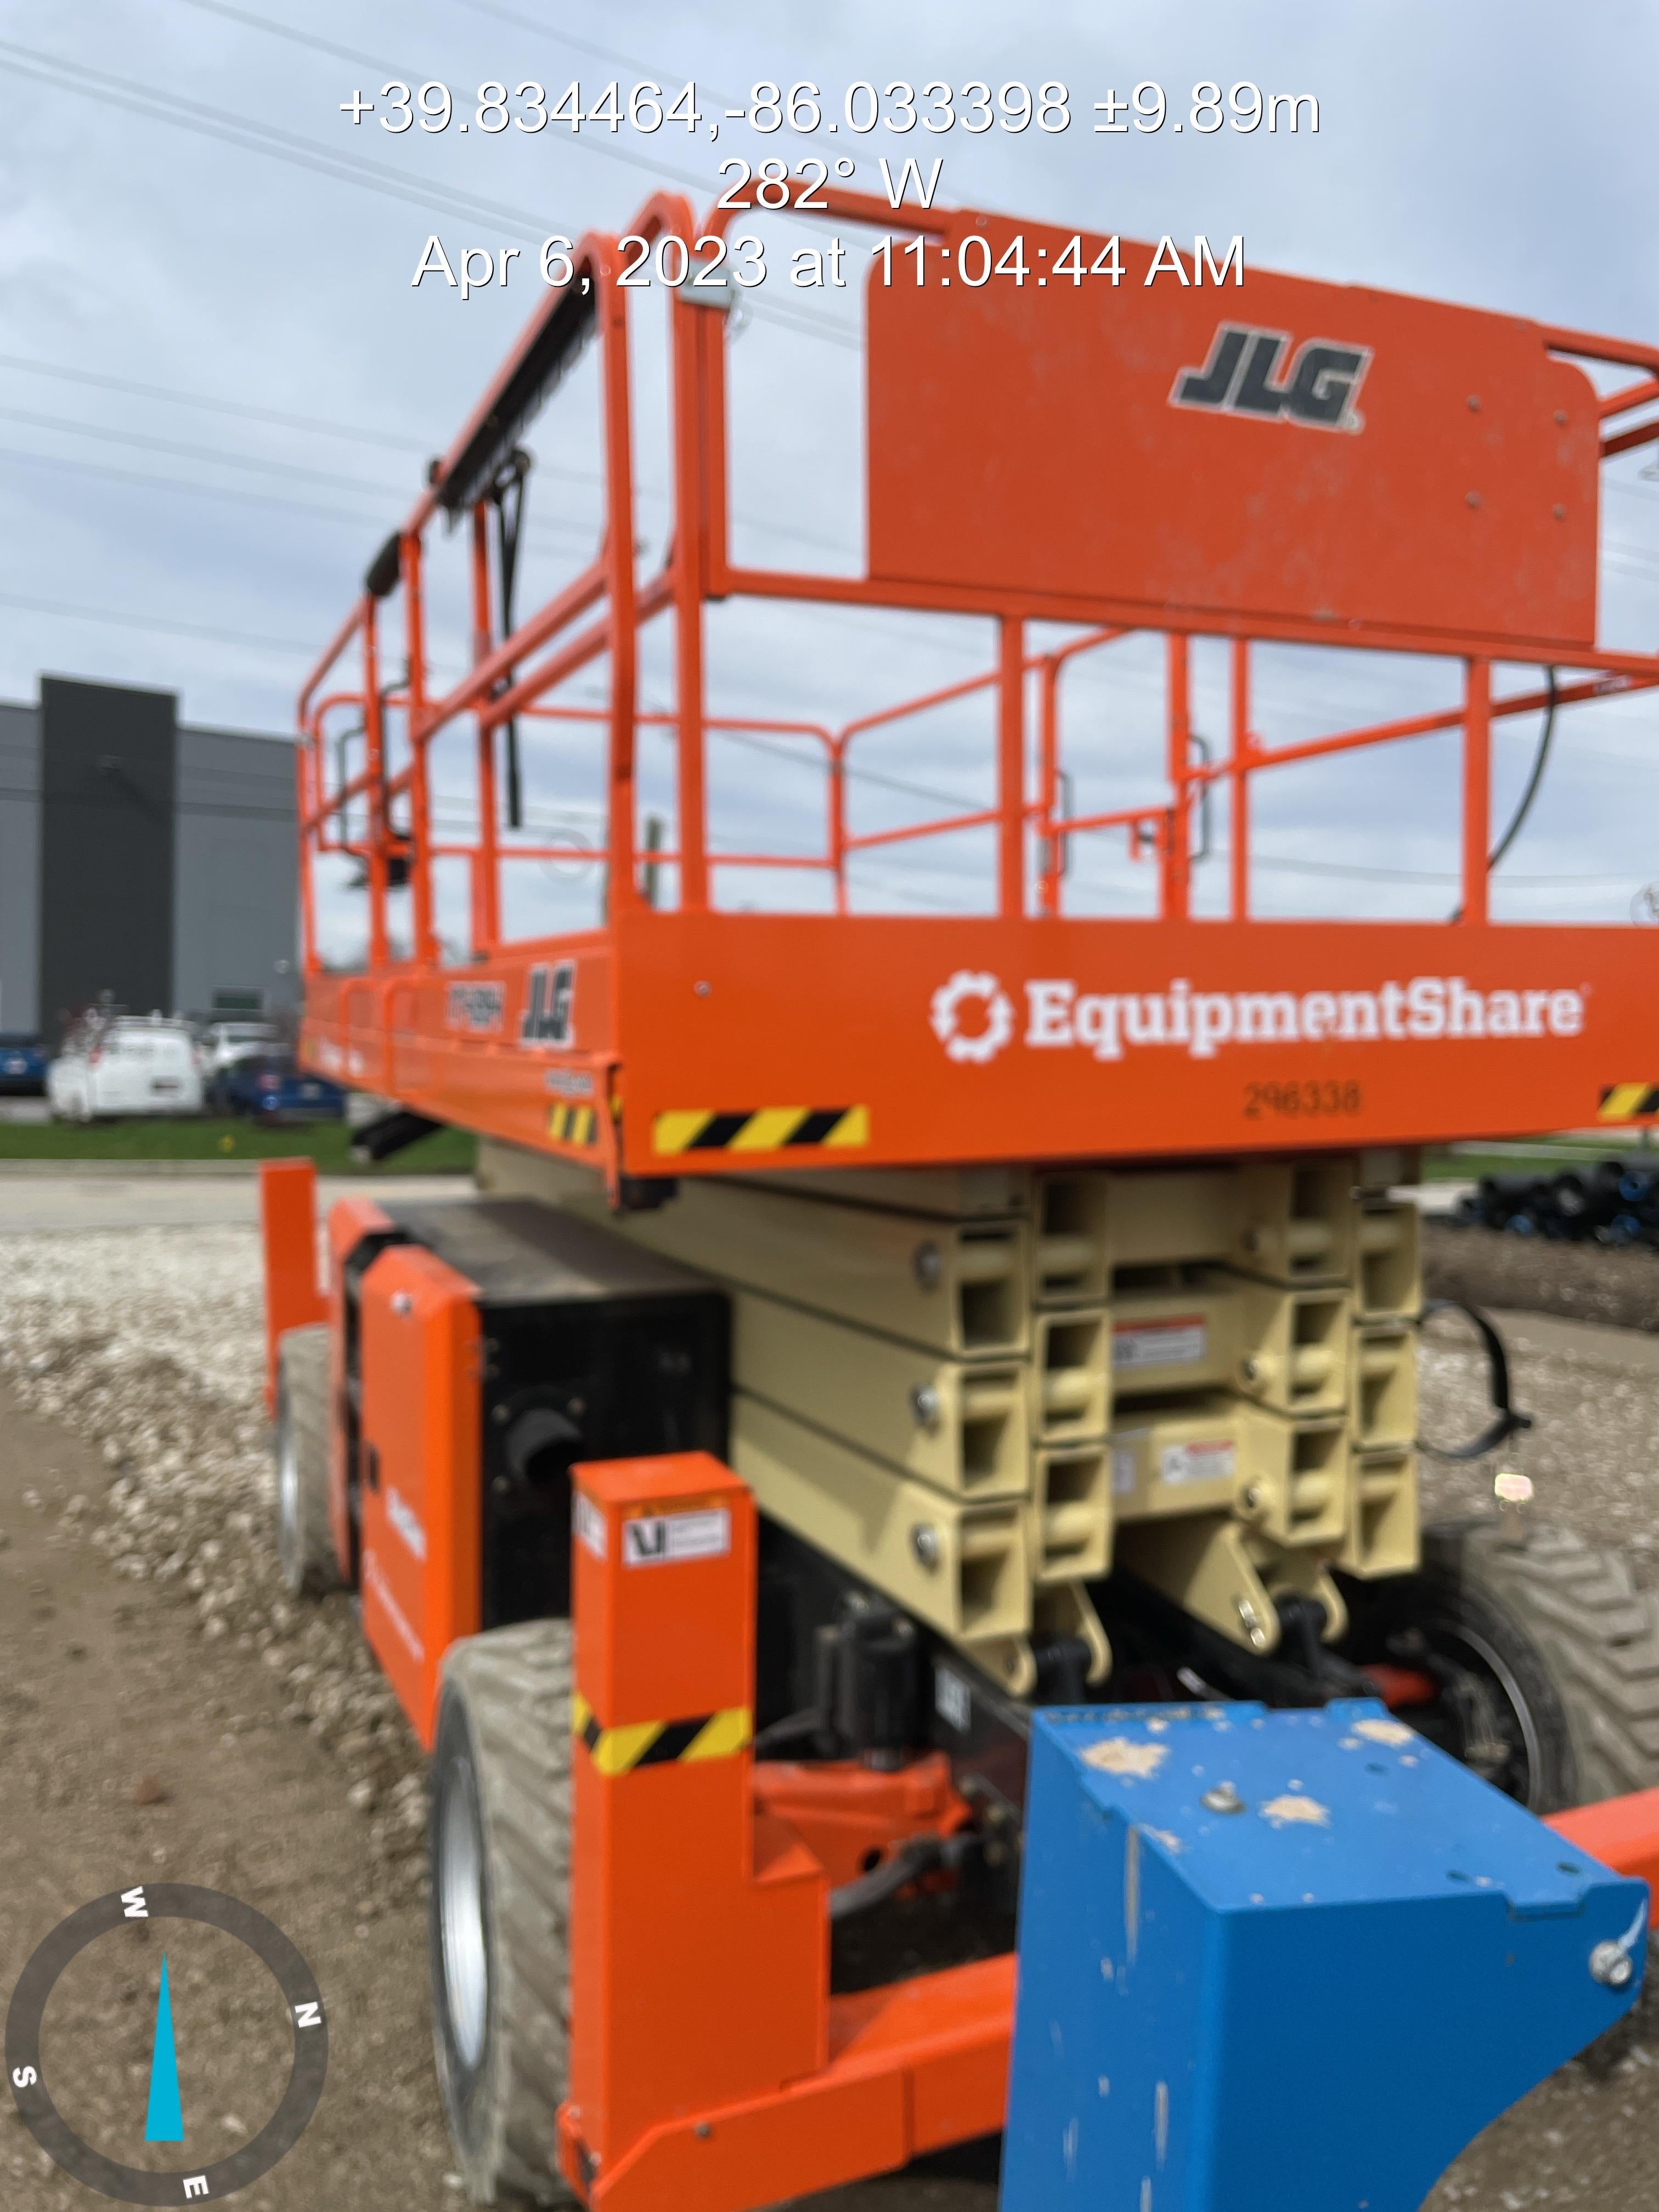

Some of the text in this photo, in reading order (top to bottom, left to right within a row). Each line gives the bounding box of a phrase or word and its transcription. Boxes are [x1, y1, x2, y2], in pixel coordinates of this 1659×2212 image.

[1173, 324, 1372, 429] JLG
[520, 962, 575, 1045] JLG
[1025, 976, 1584, 1060] EquipmentShare
